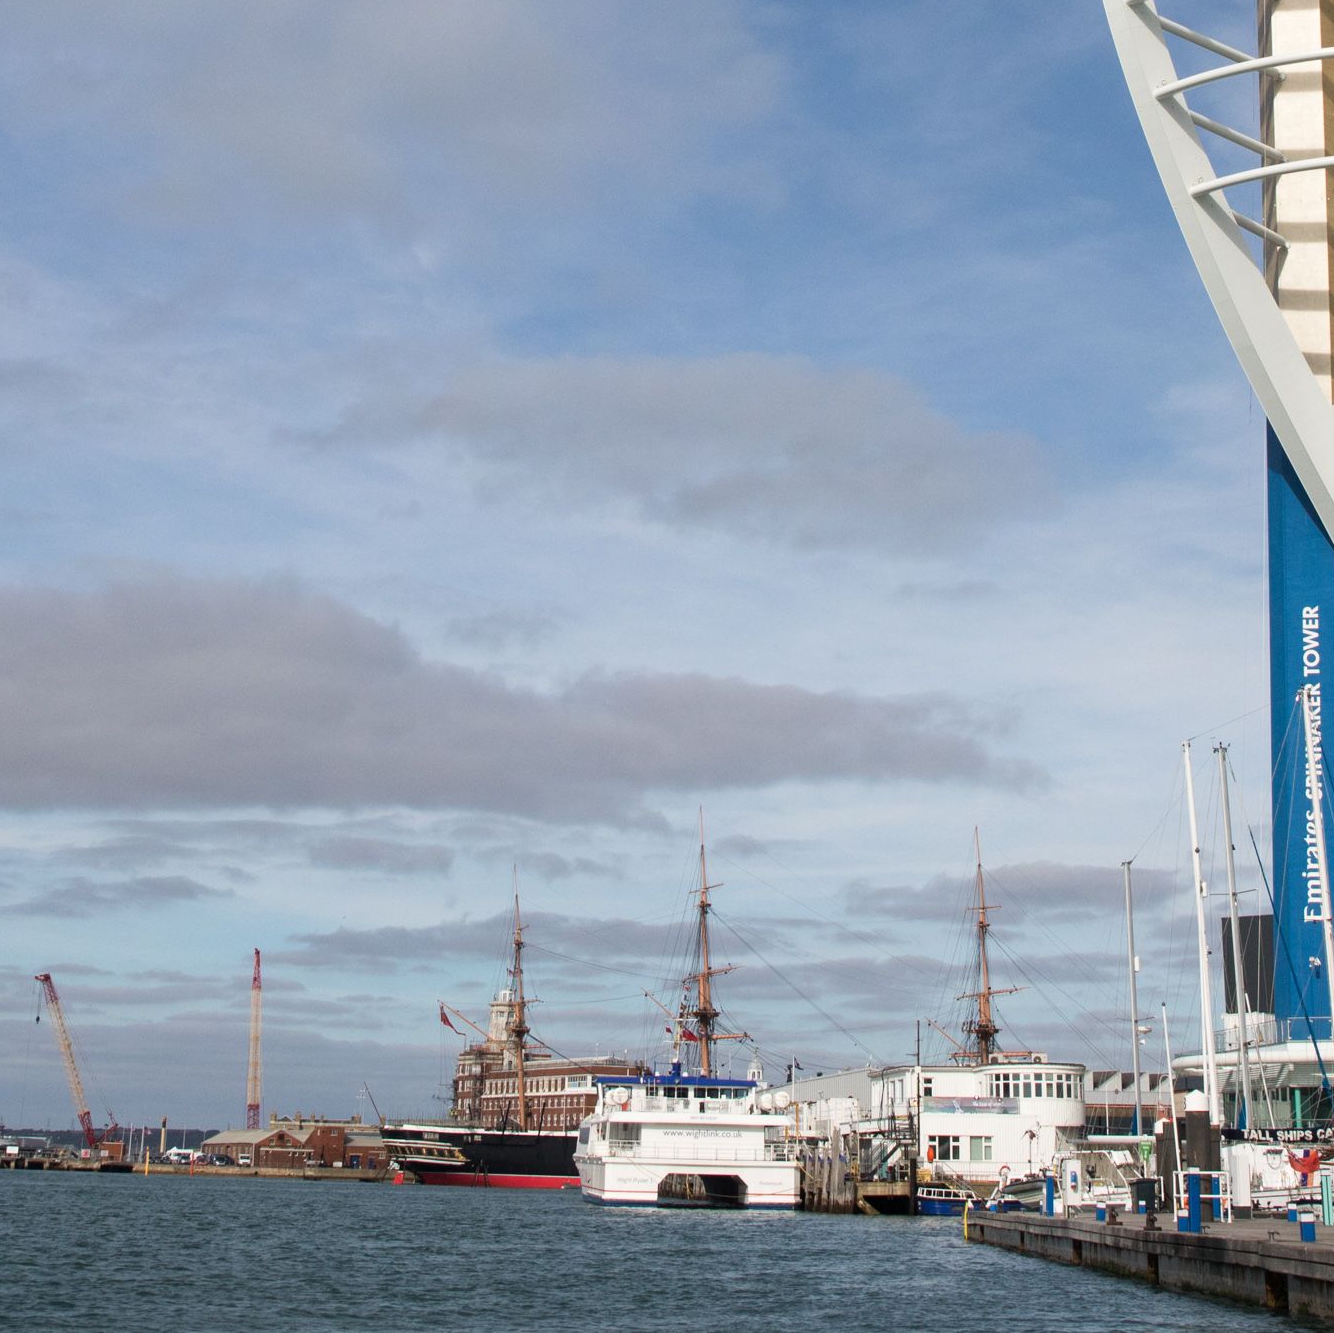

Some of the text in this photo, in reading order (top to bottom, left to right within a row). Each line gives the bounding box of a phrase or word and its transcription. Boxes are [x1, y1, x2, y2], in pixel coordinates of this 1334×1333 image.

[1303, 606, 1320, 676] TOWER
[1302, 810, 1323, 922] Emirates
[663, 1129, 743, 1138] www.wightlink.co.uk
[1243, 1129, 1274, 1143] TALL
[1277, 1130, 1313, 1141] SHIPS
